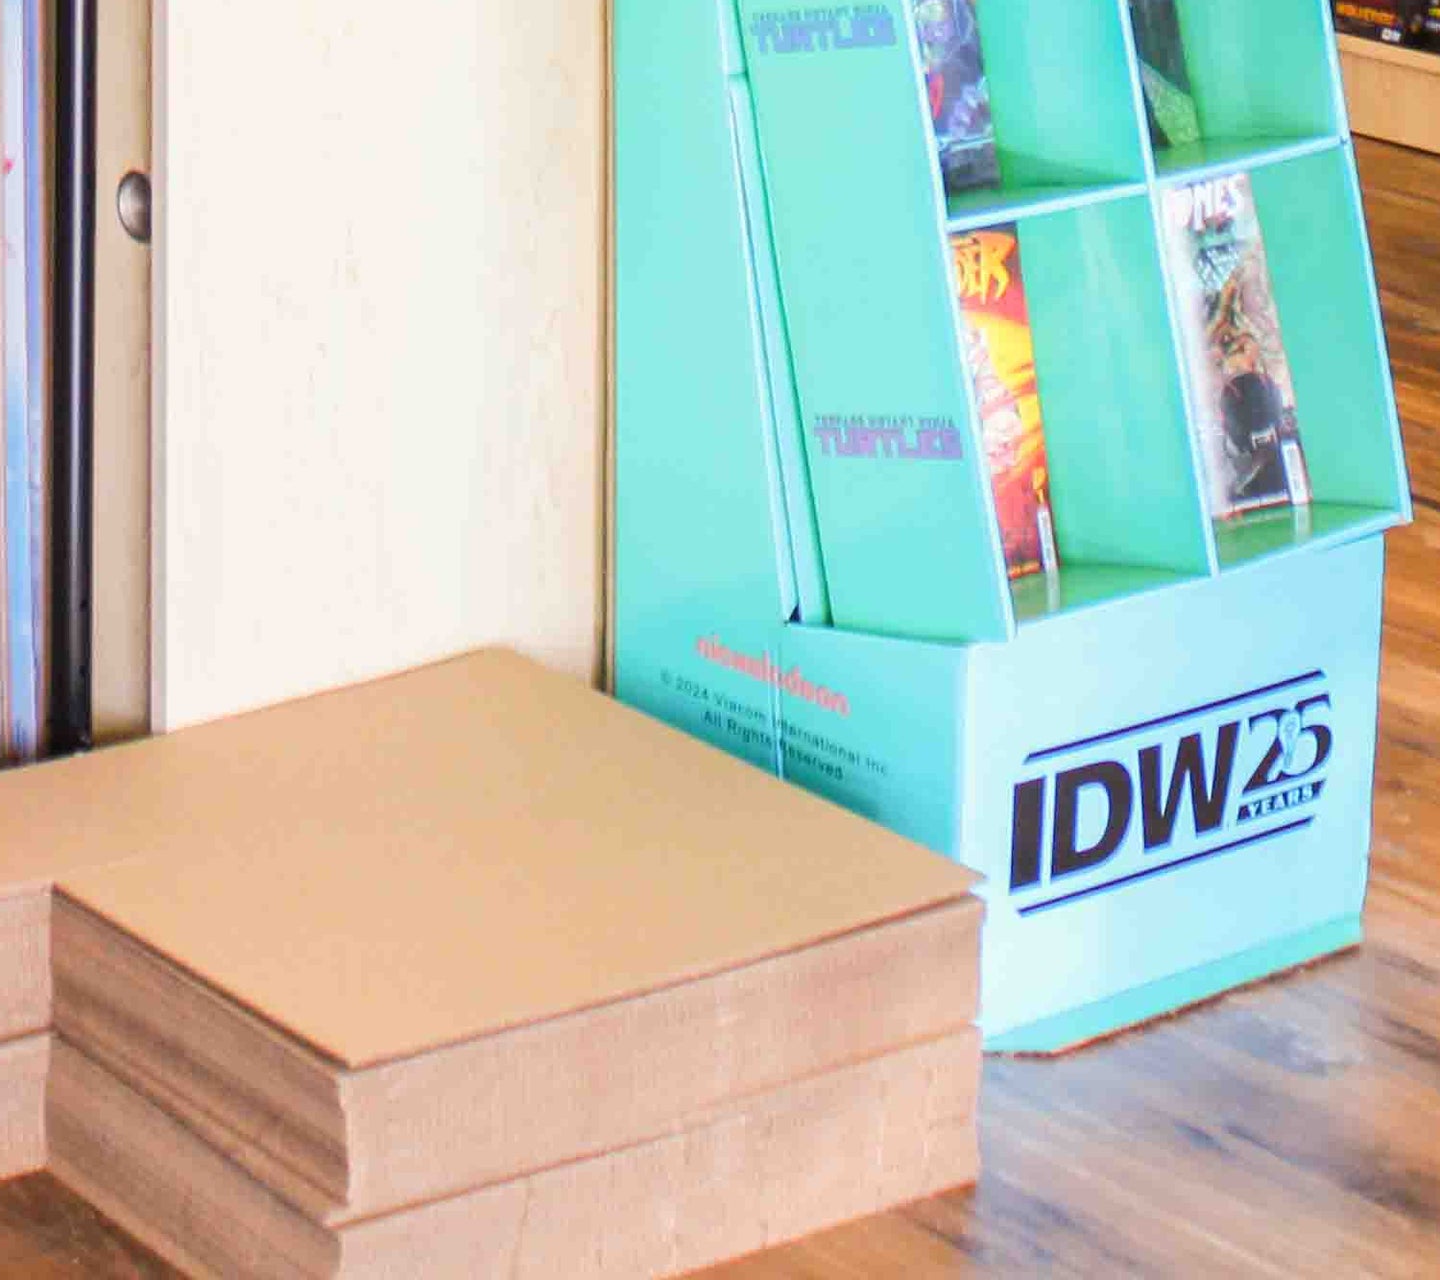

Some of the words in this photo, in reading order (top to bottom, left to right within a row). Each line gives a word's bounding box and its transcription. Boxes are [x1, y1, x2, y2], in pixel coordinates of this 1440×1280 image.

[749, 12, 897, 55] TURTLES
[1165, 178, 1245, 232] ONES
[954, 232, 1016, 305] DER
[812, 426, 963, 461] TURTLES
[694, 632, 853, 719] nickelodeon
[676, 676, 710, 701] 2024
[714, 691, 768, 723] Viacom
[771, 712, 861, 768] International
[703, 710, 721, 729] All
[726, 719, 772, 745] Rights
[775, 738, 845, 782] Reserved
[1007, 719, 1242, 896] IDW
[1241, 692, 1334, 796] 25
[1246, 783, 1316, 820] YEARS
